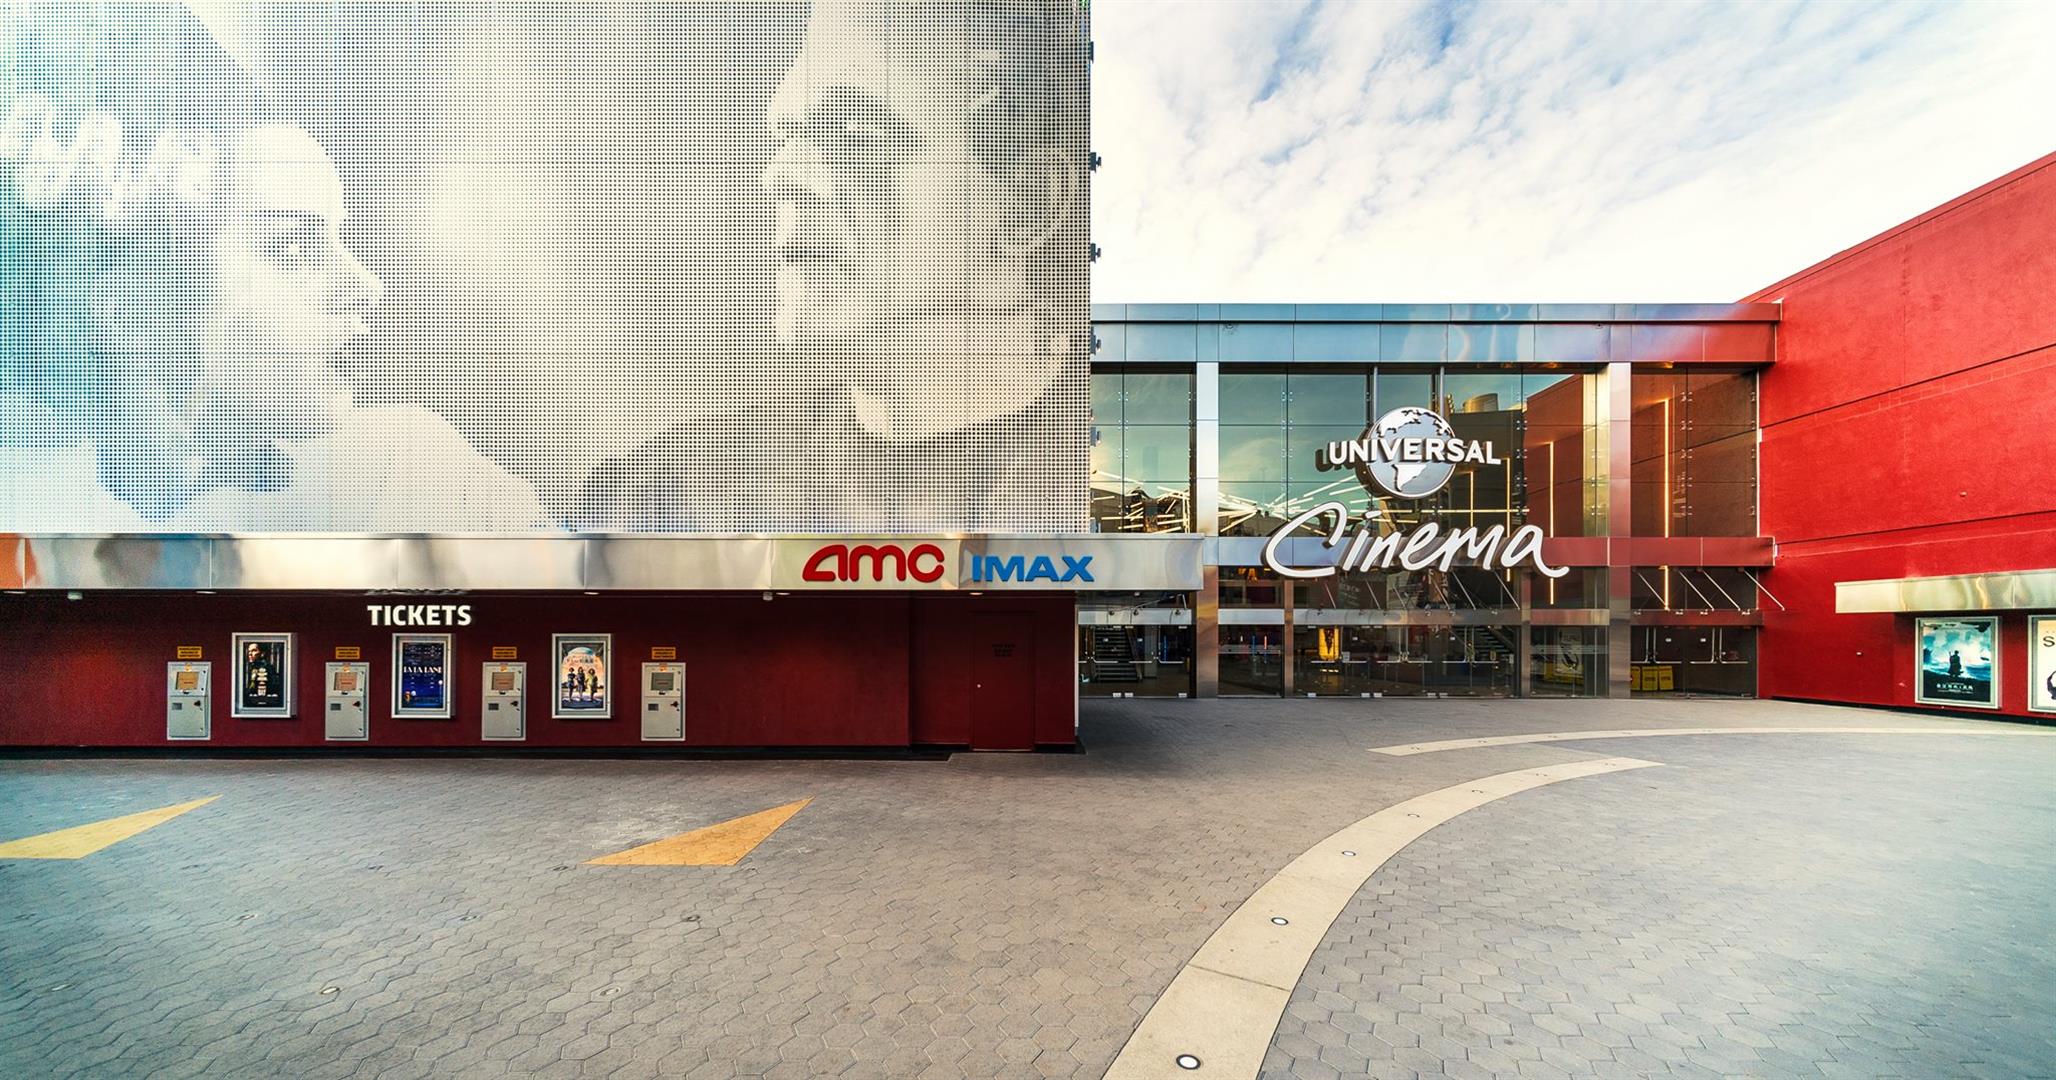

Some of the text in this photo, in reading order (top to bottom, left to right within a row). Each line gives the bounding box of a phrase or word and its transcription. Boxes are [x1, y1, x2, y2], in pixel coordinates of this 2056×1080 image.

[1328, 438, 1502, 466] UNIVERSAL
[1264, 501, 1570, 579] Cinema
[971, 554, 1095, 583] IMAX
[366, 604, 472, 627] TICKETS
